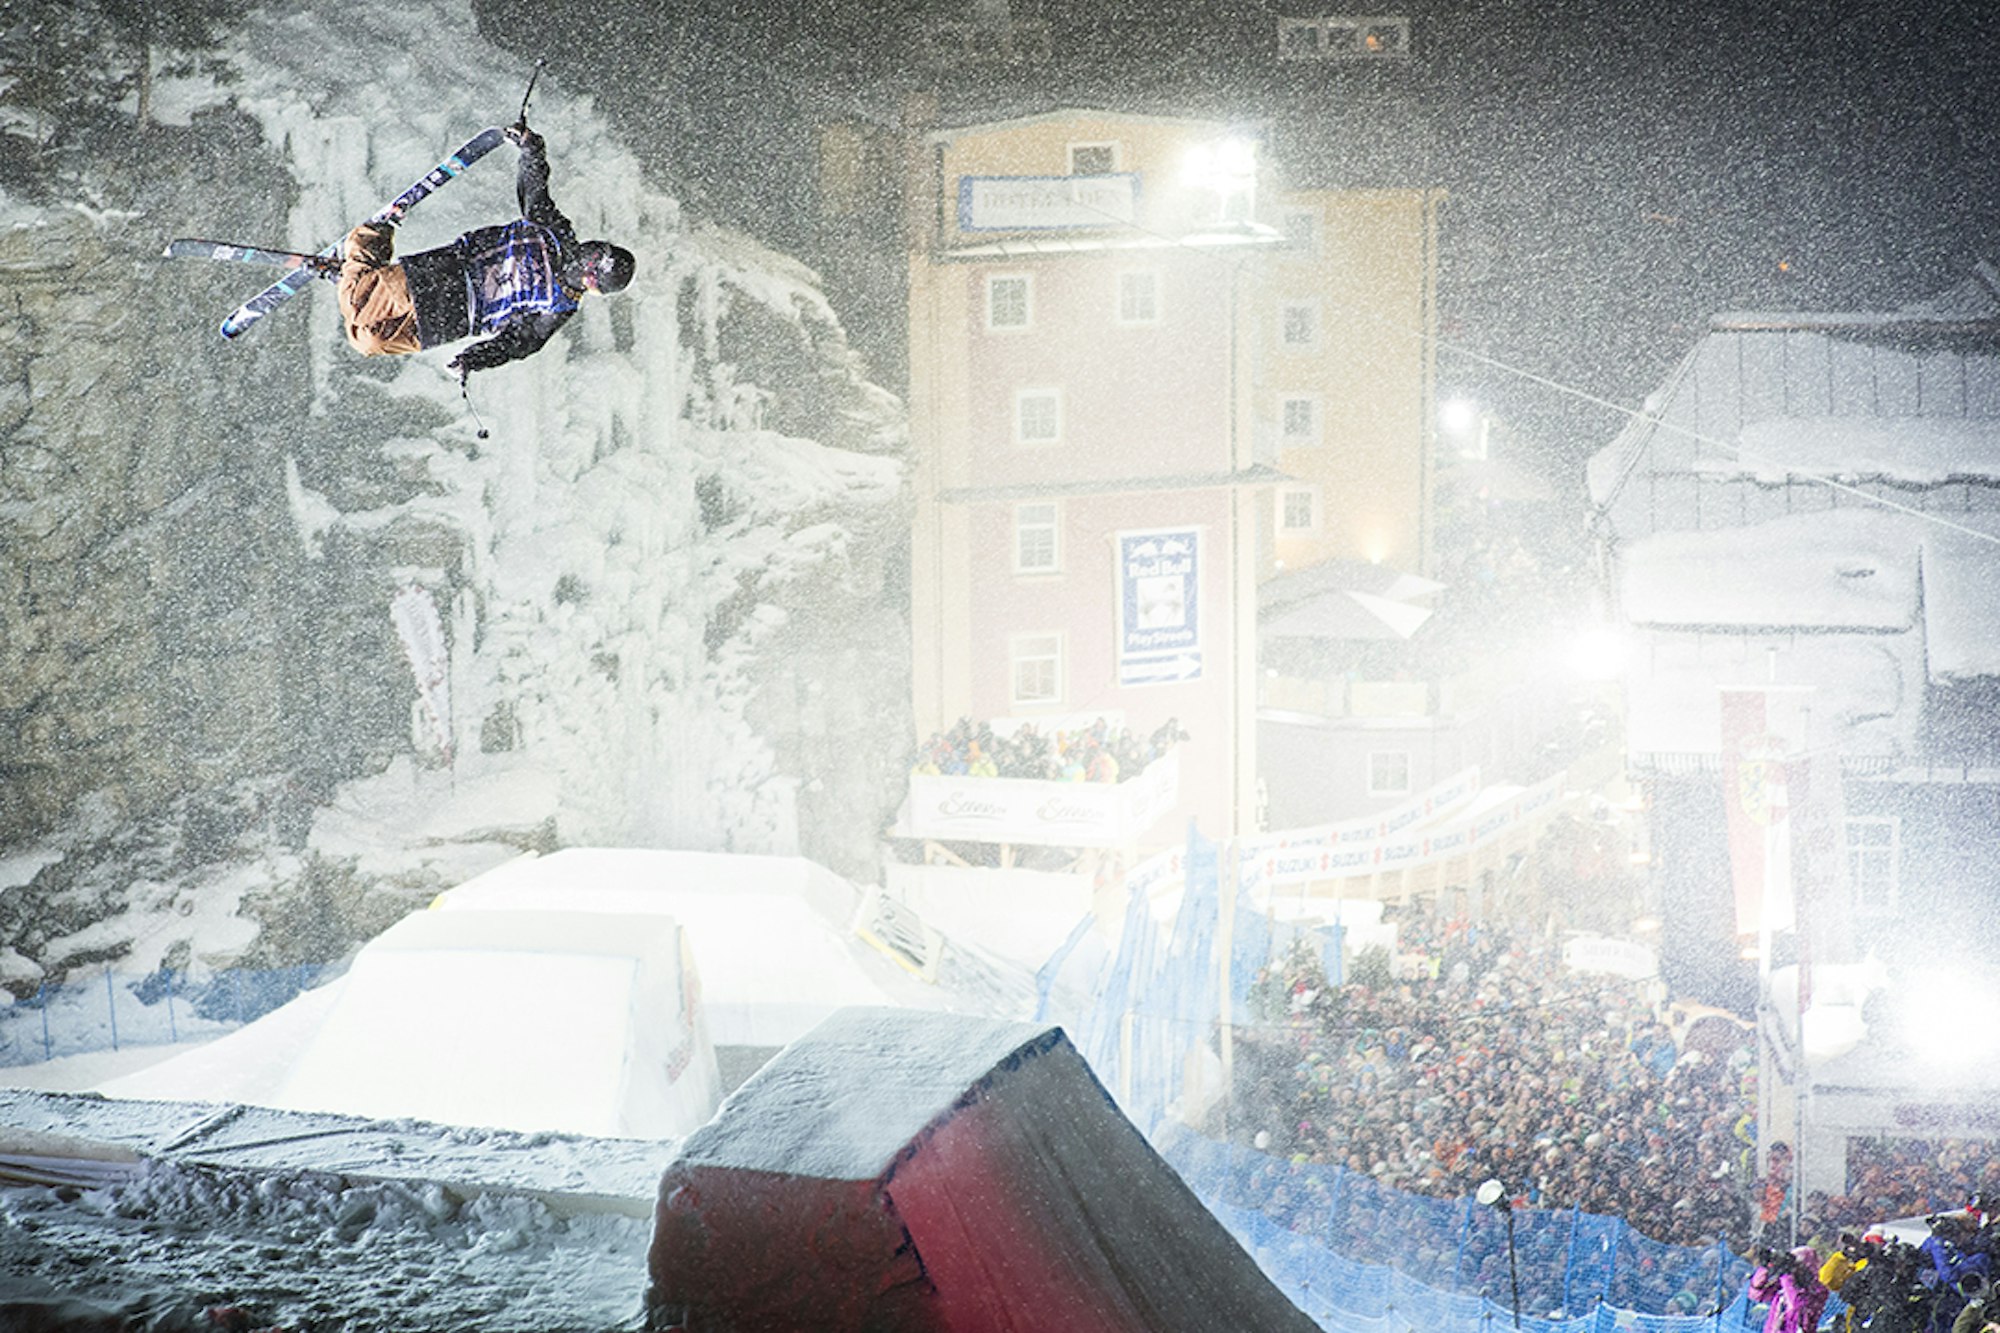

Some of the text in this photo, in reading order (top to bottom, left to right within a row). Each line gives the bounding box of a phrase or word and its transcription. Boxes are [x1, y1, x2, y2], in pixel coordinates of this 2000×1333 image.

[1129, 558, 1192, 578] Red Bull
[1434, 783, 1465, 808] SUZUKI
[1388, 807, 1422, 834] SUZUKI
[1478, 811, 1510, 838] SUZUKI
[1433, 832, 1466, 852] SUZUKI
[1331, 850, 1370, 868] SUZUKI
[1384, 844, 1420, 861] SUZUKI
[1276, 857, 1317, 875] SUZUKI
